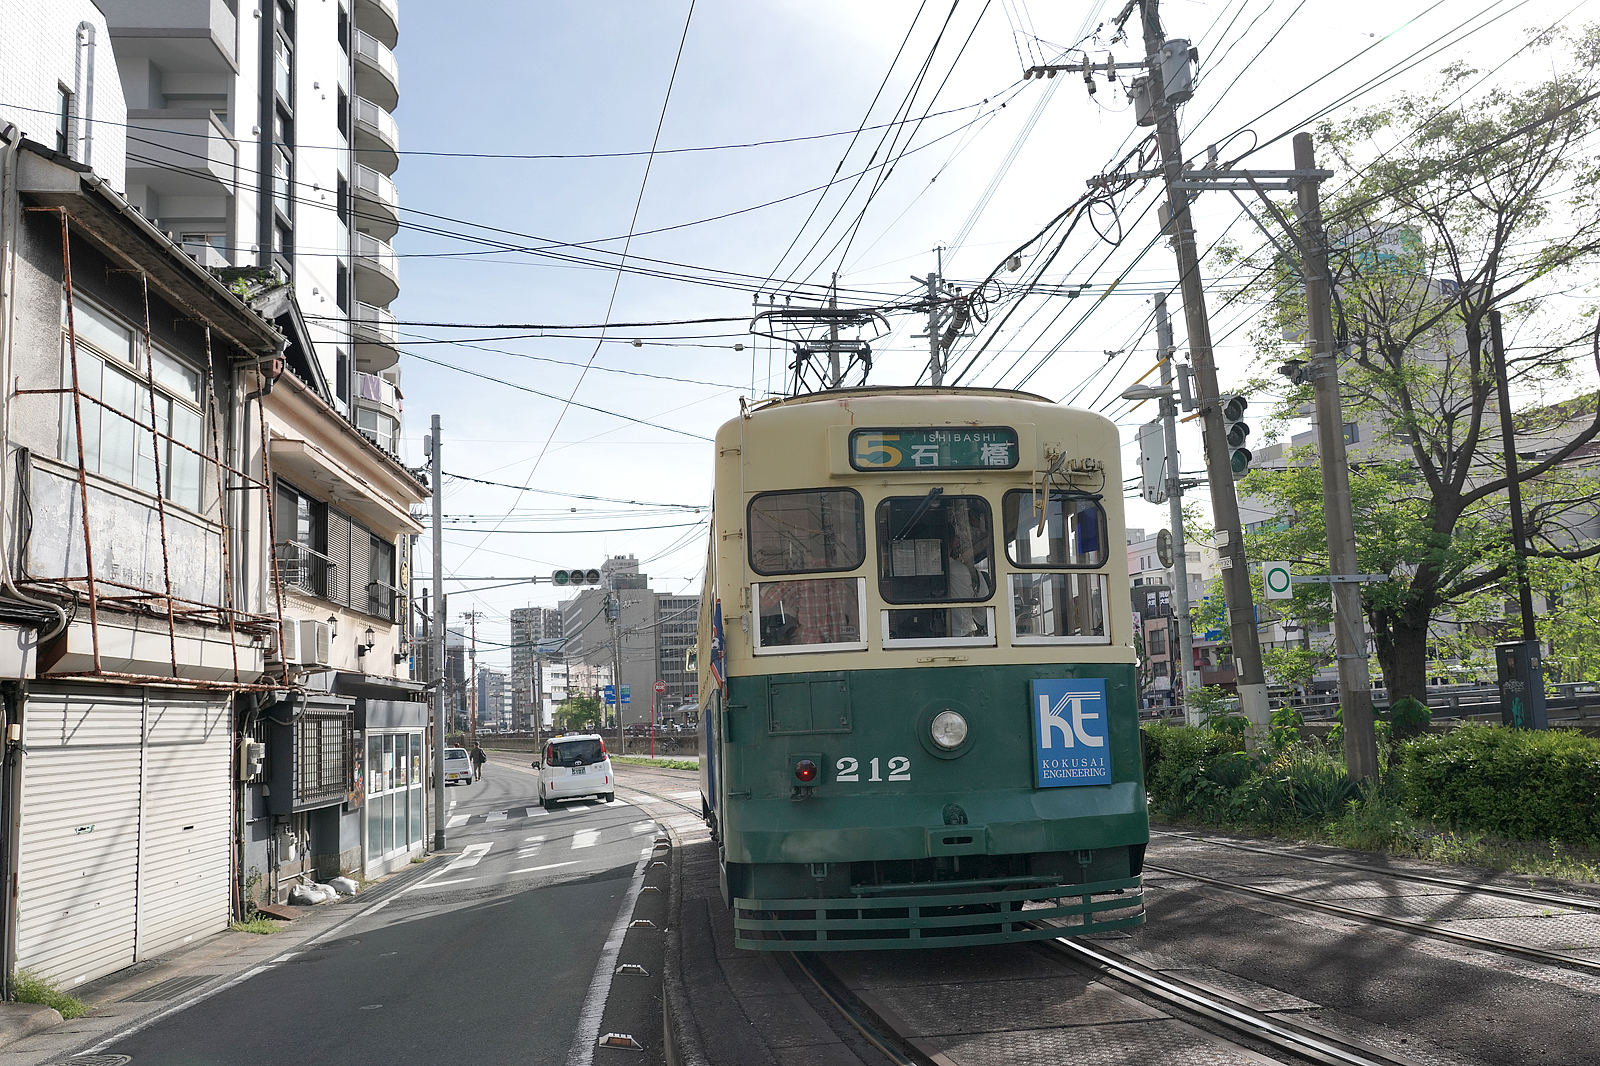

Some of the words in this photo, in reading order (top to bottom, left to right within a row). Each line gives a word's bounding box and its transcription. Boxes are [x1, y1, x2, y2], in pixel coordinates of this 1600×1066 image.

[923, 433, 996, 443] ISHIBASHI
[855, 435, 903, 468] 5
[911, 443, 1009, 467] 石橋
[1039, 691, 1104, 749] KE
[836, 756, 911, 782] 212
[1042, 758, 1104, 769] KOKUSAI
[1043, 767, 1106, 779] ENGINEERING
